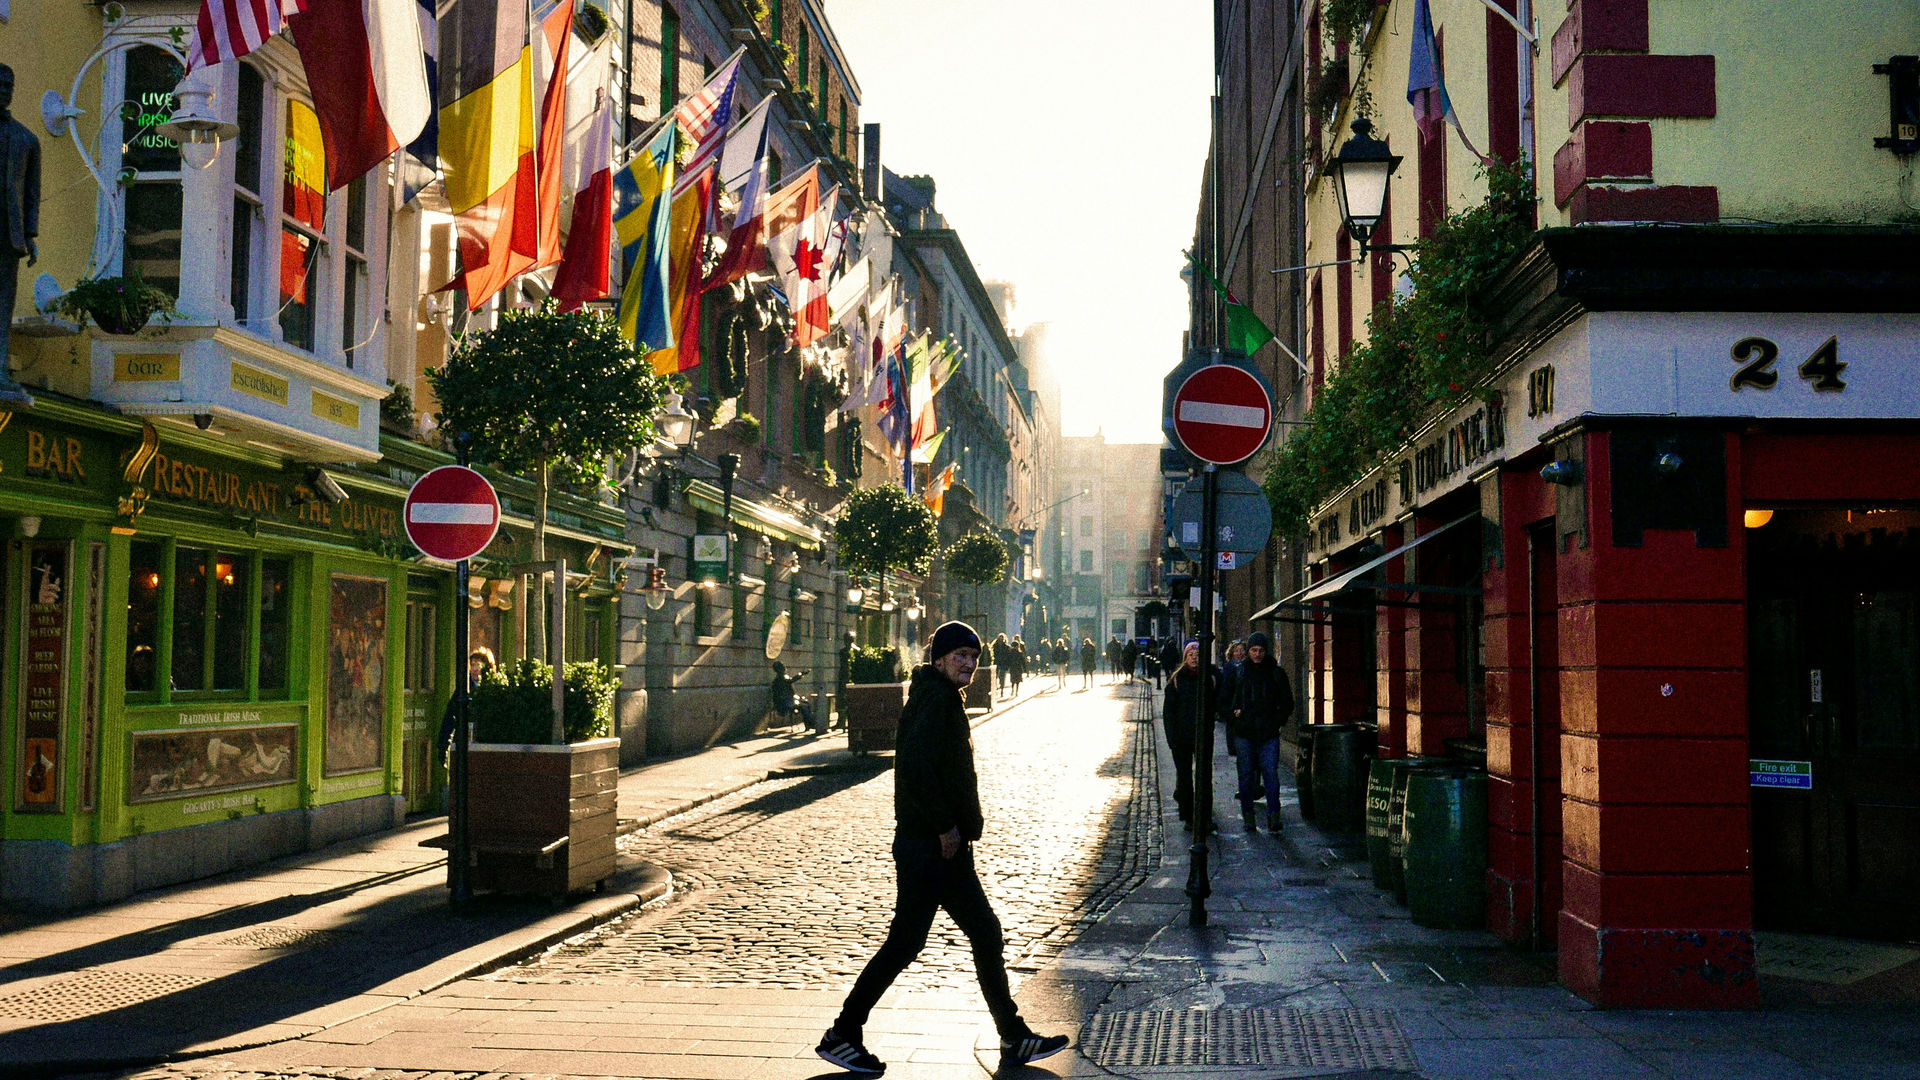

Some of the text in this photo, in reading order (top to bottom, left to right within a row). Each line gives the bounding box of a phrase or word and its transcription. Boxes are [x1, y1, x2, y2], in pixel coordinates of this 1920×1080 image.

[142, 92, 173, 107] LIVE
[1902, 126, 1915, 137] 10
[134, 134, 179, 149] MUSIC
[1730, 335, 1849, 393] 24
[27, 430, 86, 478] BAR
[154, 453, 280, 515] RESTAURANT
[295, 484, 332, 525] THE
[341, 498, 398, 537] OLIVER
[28, 711, 57, 722] MUSIC
[1760, 763, 1797, 772] Fire exit
[1757, 775, 1800, 785] Keep clear
